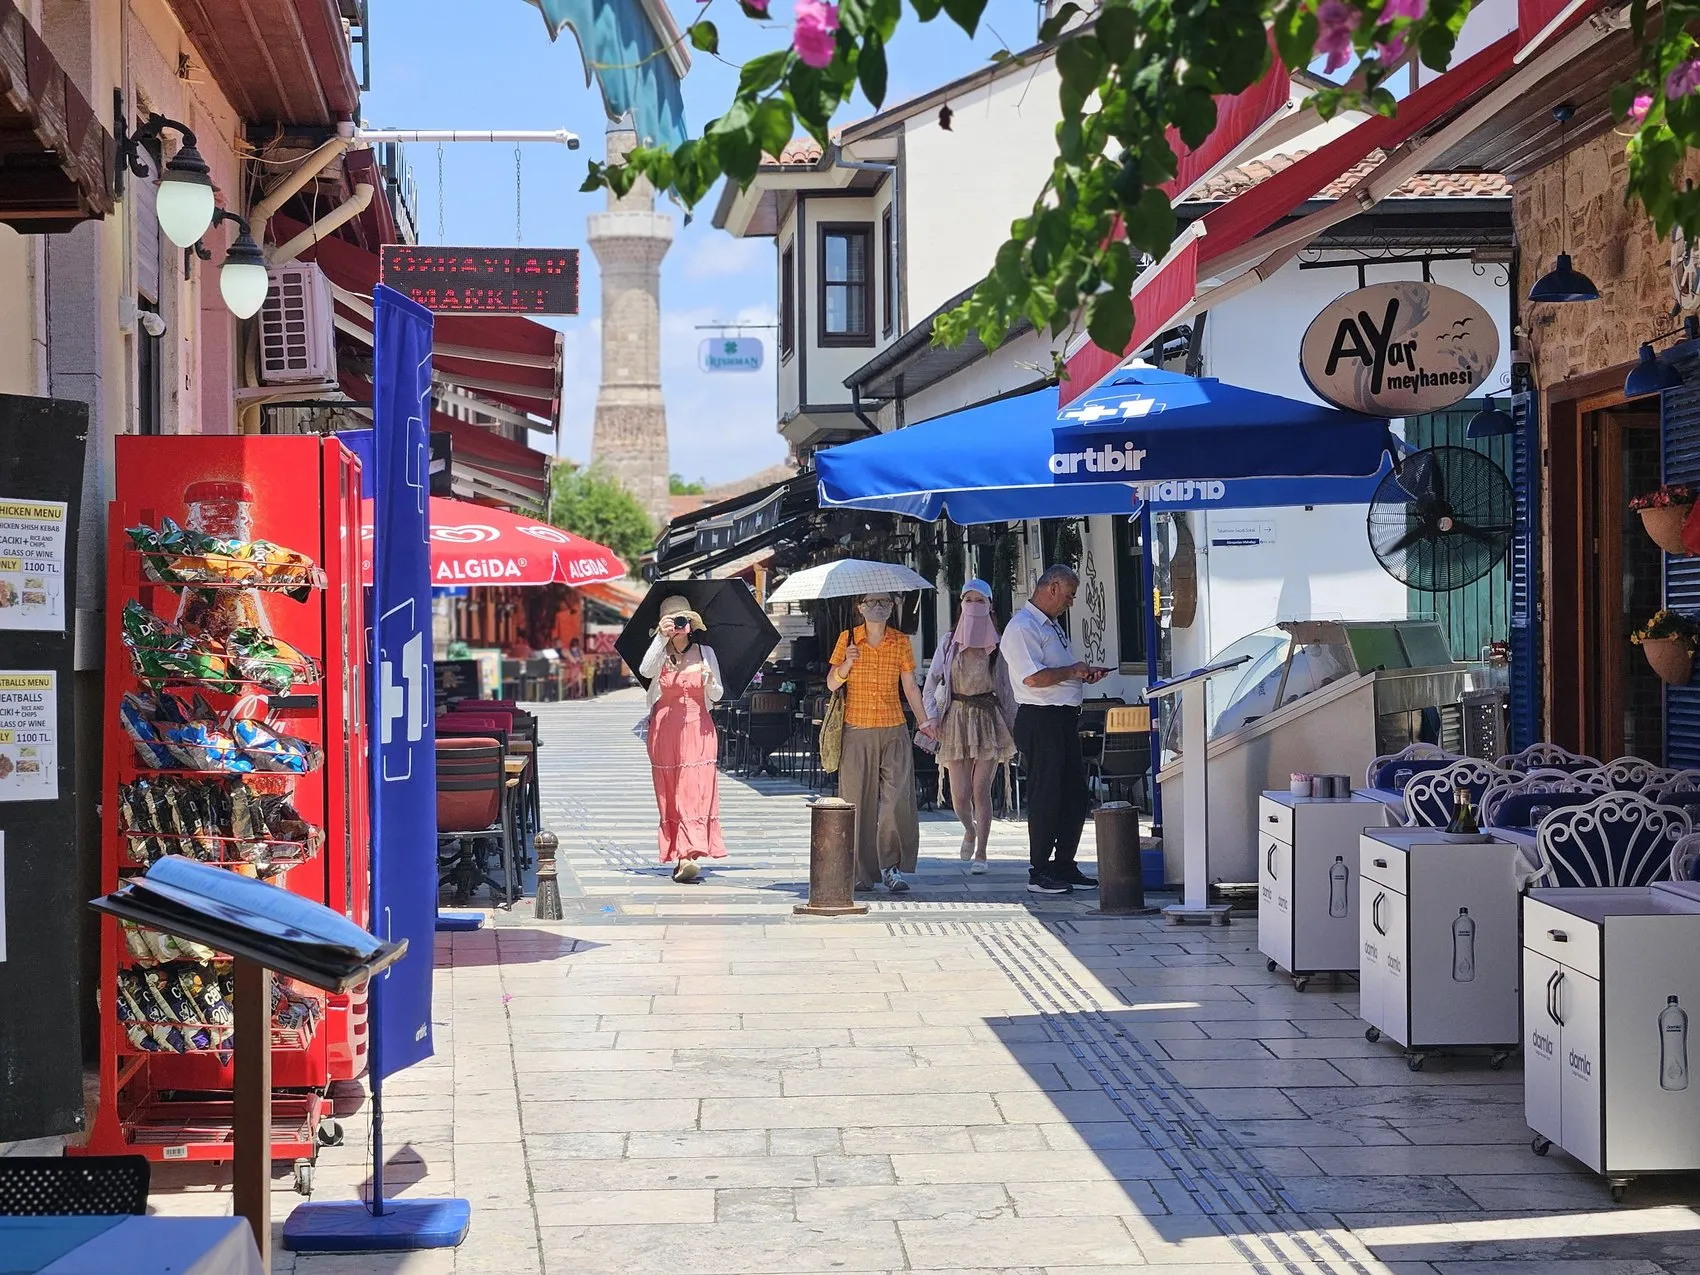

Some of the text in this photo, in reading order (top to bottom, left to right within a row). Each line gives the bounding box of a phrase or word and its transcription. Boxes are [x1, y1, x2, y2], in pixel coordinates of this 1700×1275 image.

[1387, 365, 1473, 394] meyhanesi
[33, 508, 61, 519] MENU
[3, 549, 24, 557] GLASS
[24, 562, 45, 572] 1100
[47, 563, 59, 573] TL.
[27, 679, 50, 687] MENU
[17, 720, 27, 728] OF
[28, 719, 46, 728] WINE
[17, 733, 38, 743] 1100
[39, 733, 51, 742] TL.
[1532, 1028, 1553, 1055] damla
[1568, 1047, 1591, 1076] damla
